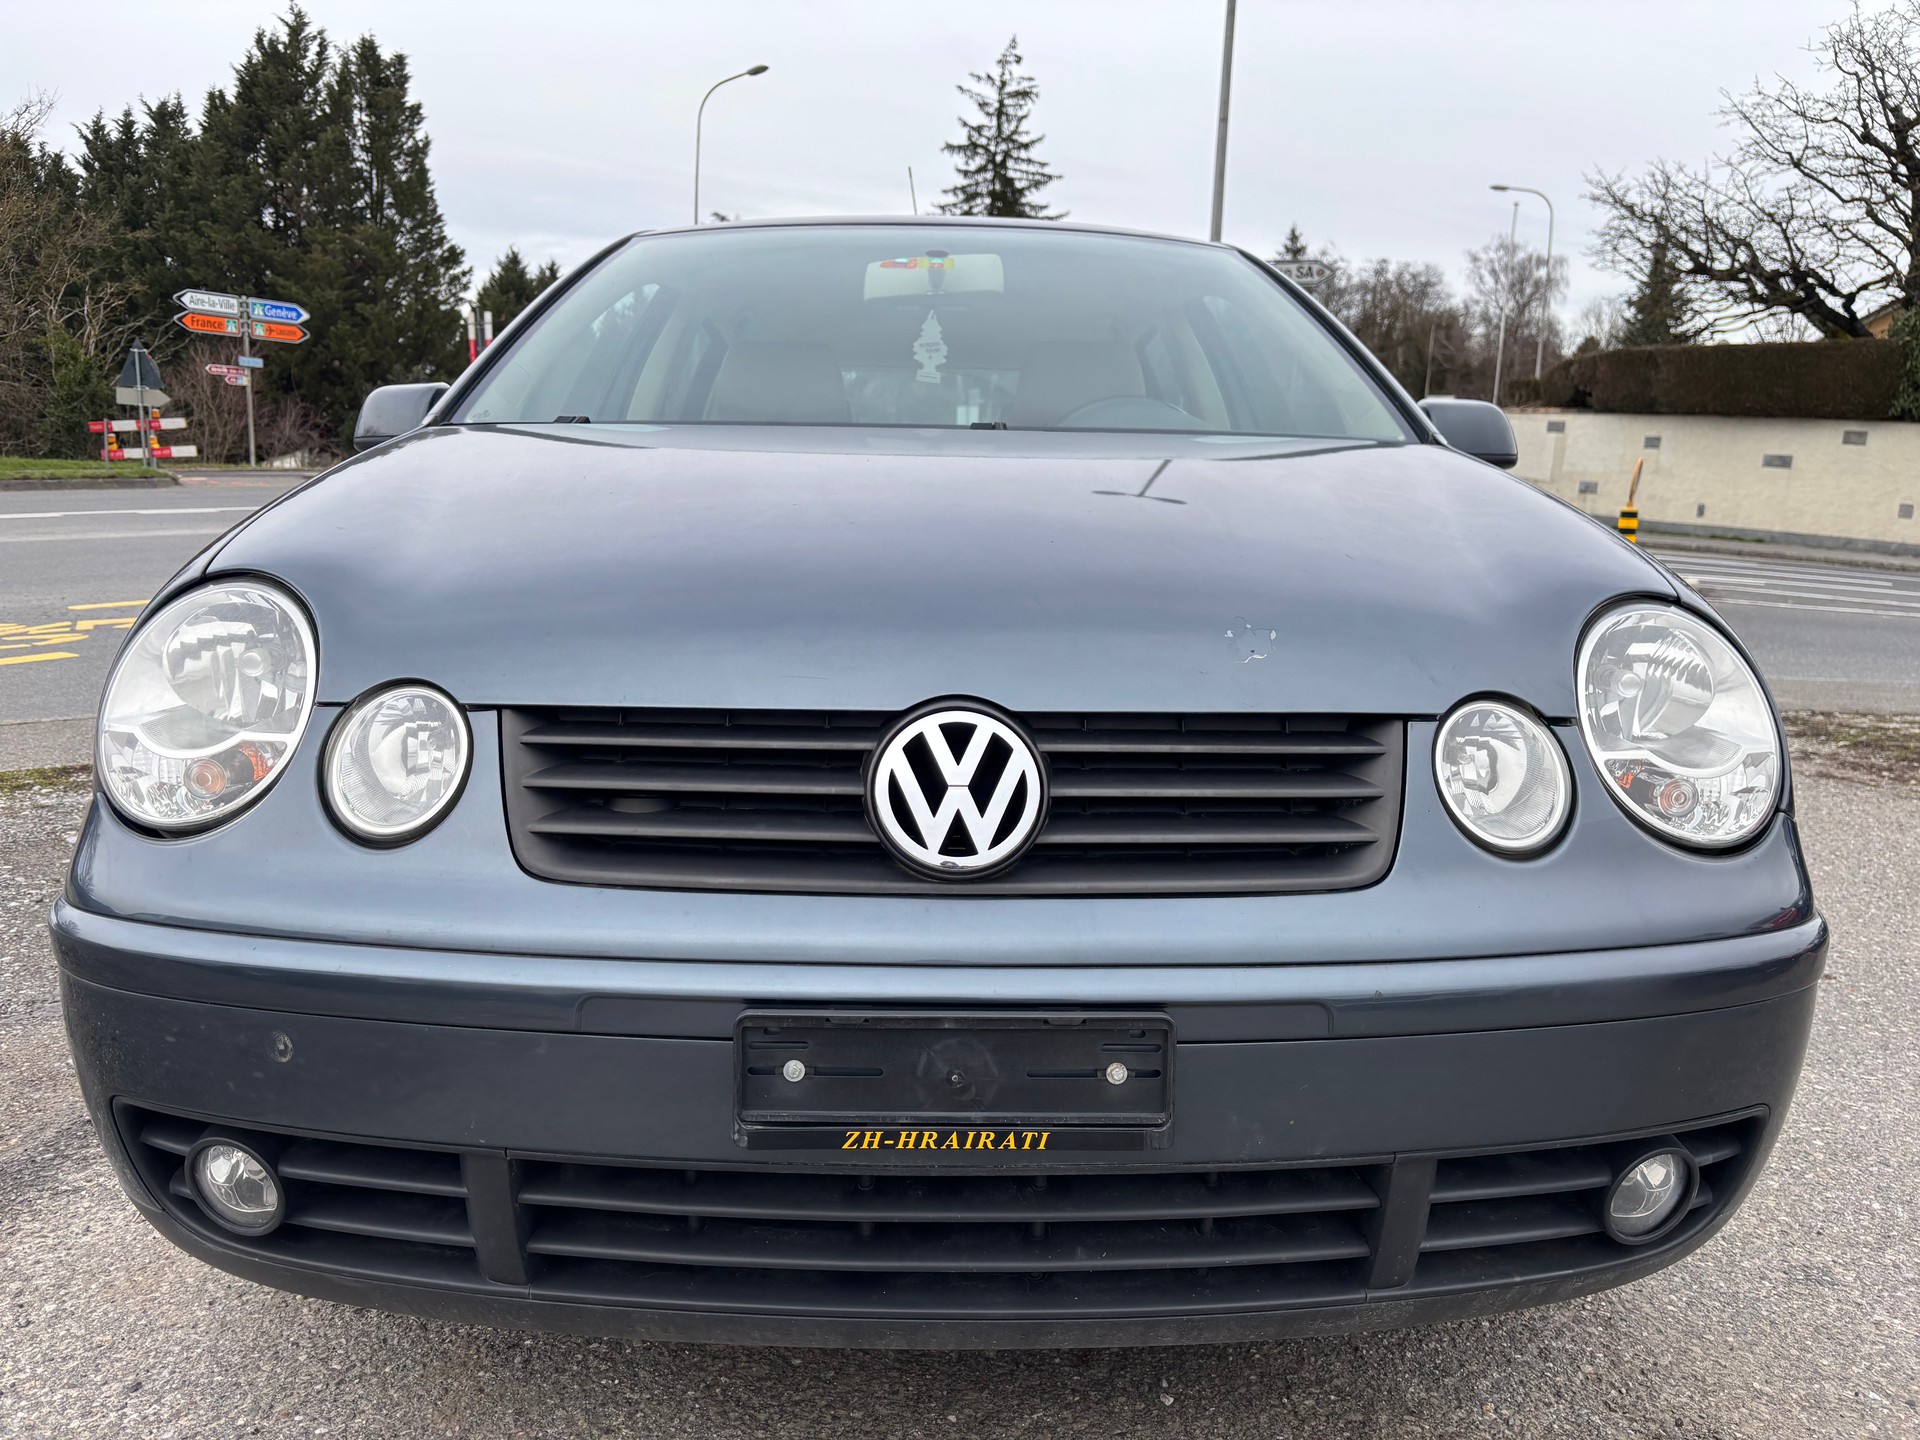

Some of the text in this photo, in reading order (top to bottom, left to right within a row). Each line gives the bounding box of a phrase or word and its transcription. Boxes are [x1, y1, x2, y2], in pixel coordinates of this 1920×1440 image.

[188, 294, 236, 311] Aire-la-Ville
[264, 304, 298, 320] Genève
[190, 315, 224, 330] France
[875, 711, 1040, 868] VW
[841, 1130, 1052, 1151] ZH-HRAIRATI
